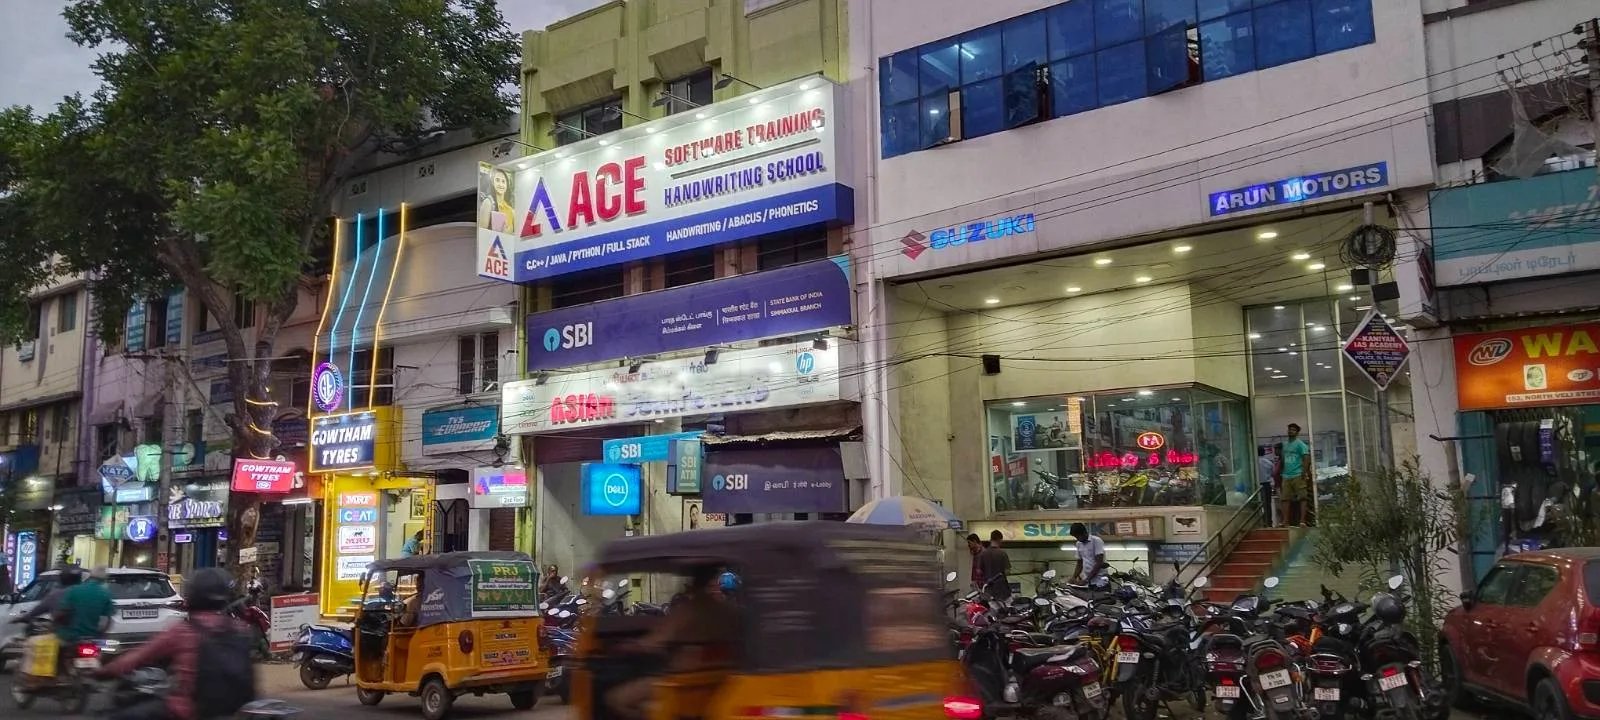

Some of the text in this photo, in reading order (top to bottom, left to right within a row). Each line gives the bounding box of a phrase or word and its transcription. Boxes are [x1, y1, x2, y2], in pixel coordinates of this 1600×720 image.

[664, 107, 826, 167] SOFTWARE TRAINING
[664, 151, 825, 207] HANDWRITING SCHOOL
[567, 155, 648, 231] ACE
[1216, 167, 1381, 211] ARUN MOTORS
[666, 220, 721, 242] HANDWRITING
[728, 212, 762, 230] ABACUS
[769, 200, 819, 220] PHONETICS
[930, 213, 1035, 249] SUZUKI
[550, 253, 567, 265] JAVA
[572, 246, 600, 261] PYTHON
[606, 240, 625, 255] FULL
[626, 235, 650, 250] STACK
[485, 260, 508, 277] ACE
[785, 295, 800, 304] BANK
[563, 322, 593, 349] SBI
[551, 393, 616, 426] ASIAN
[311, 424, 372, 446] GOWTHAM
[322, 447, 358, 465] TYRES
[620, 443, 641, 459] SBI
[241, 464, 292, 474] GOWTHAM
[681, 456, 697, 468] SBI
[250, 473, 280, 482] TYRES
[680, 469, 697, 480] ATM
[726, 474, 748, 491] SBI
[607, 485, 625, 495] DELL
[345, 495, 373, 505] MRF
[344, 511, 373, 521] CEAT
[1024, 521, 1114, 537] SUZKI
[492, 566, 519, 576] PRJ
